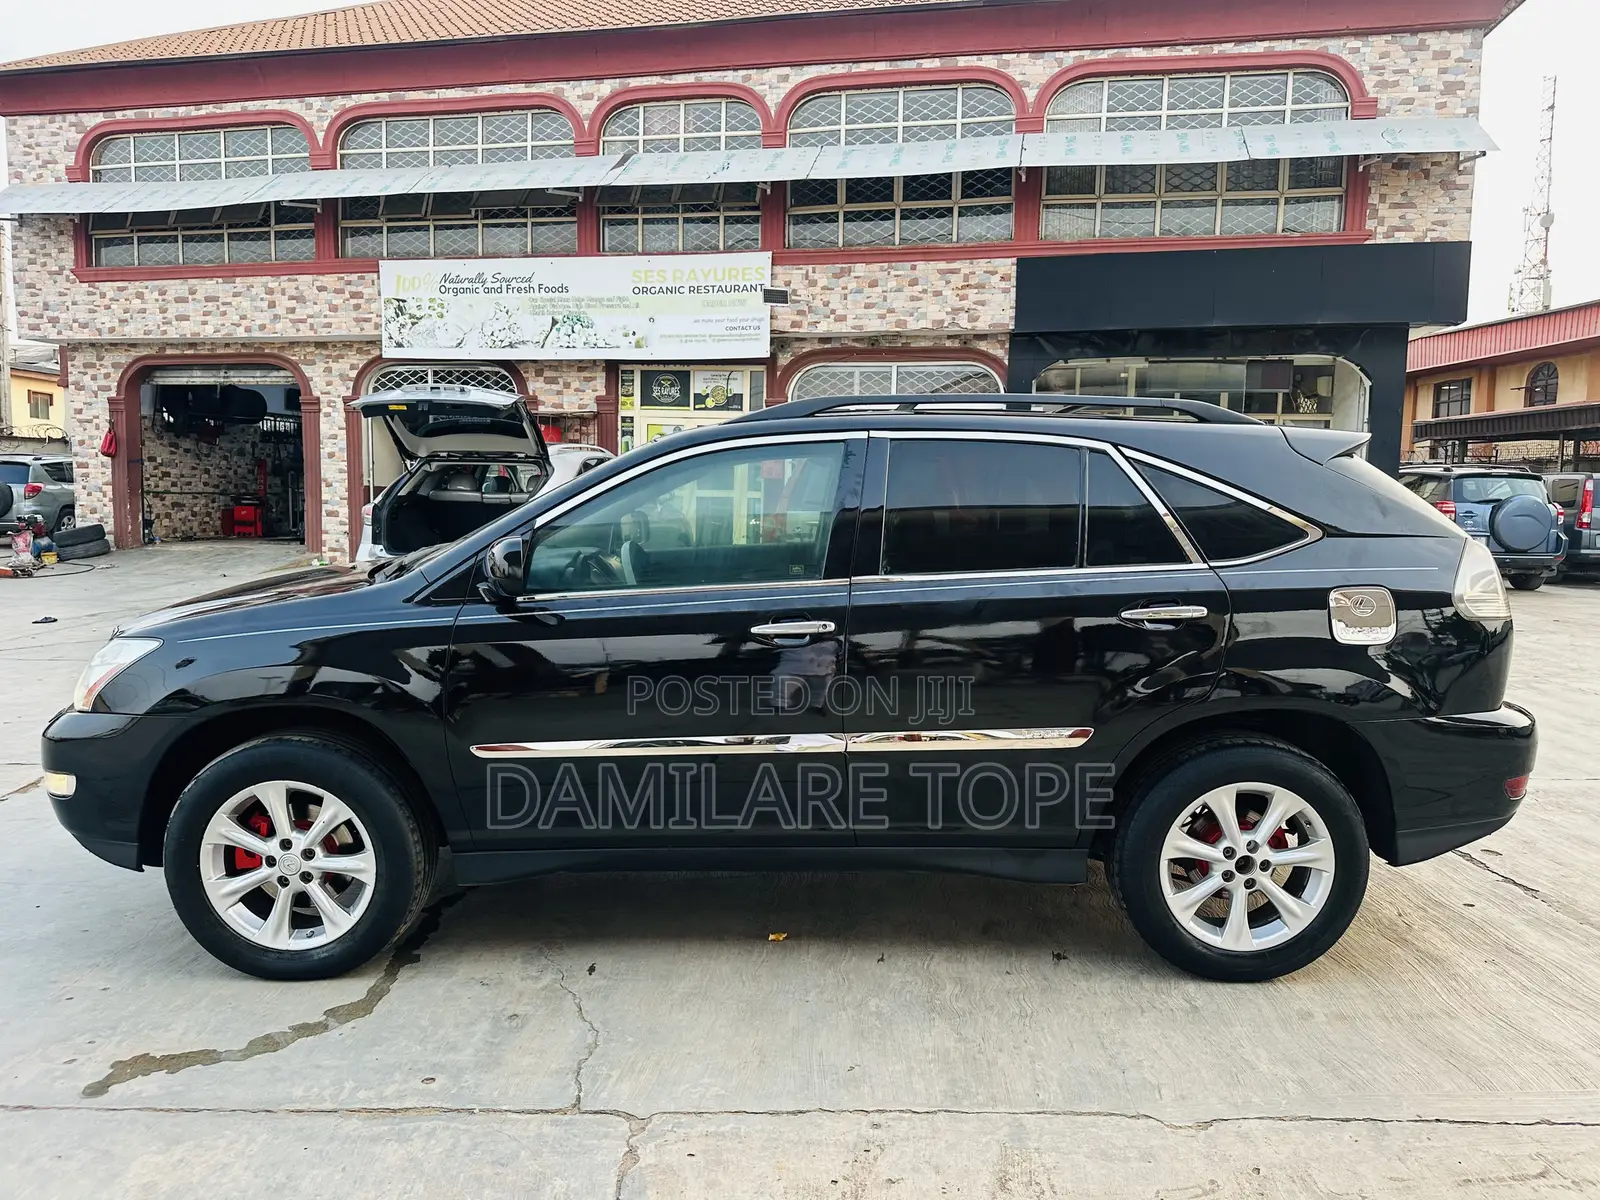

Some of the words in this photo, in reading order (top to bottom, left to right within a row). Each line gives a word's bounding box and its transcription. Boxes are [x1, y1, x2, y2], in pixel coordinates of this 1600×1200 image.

[438, 272, 489, 287] Naturally
[490, 271, 535, 284] Sourced
[631, 269, 668, 284] SES
[672, 266, 766, 283] RAYURES
[438, 284, 480, 297] Organic
[483, 284, 503, 294] and
[506, 284, 536, 294] Fresh
[538, 283, 570, 294] Foods
[632, 285, 685, 296] ORGANIC
[689, 283, 765, 294] RESTAURANT
